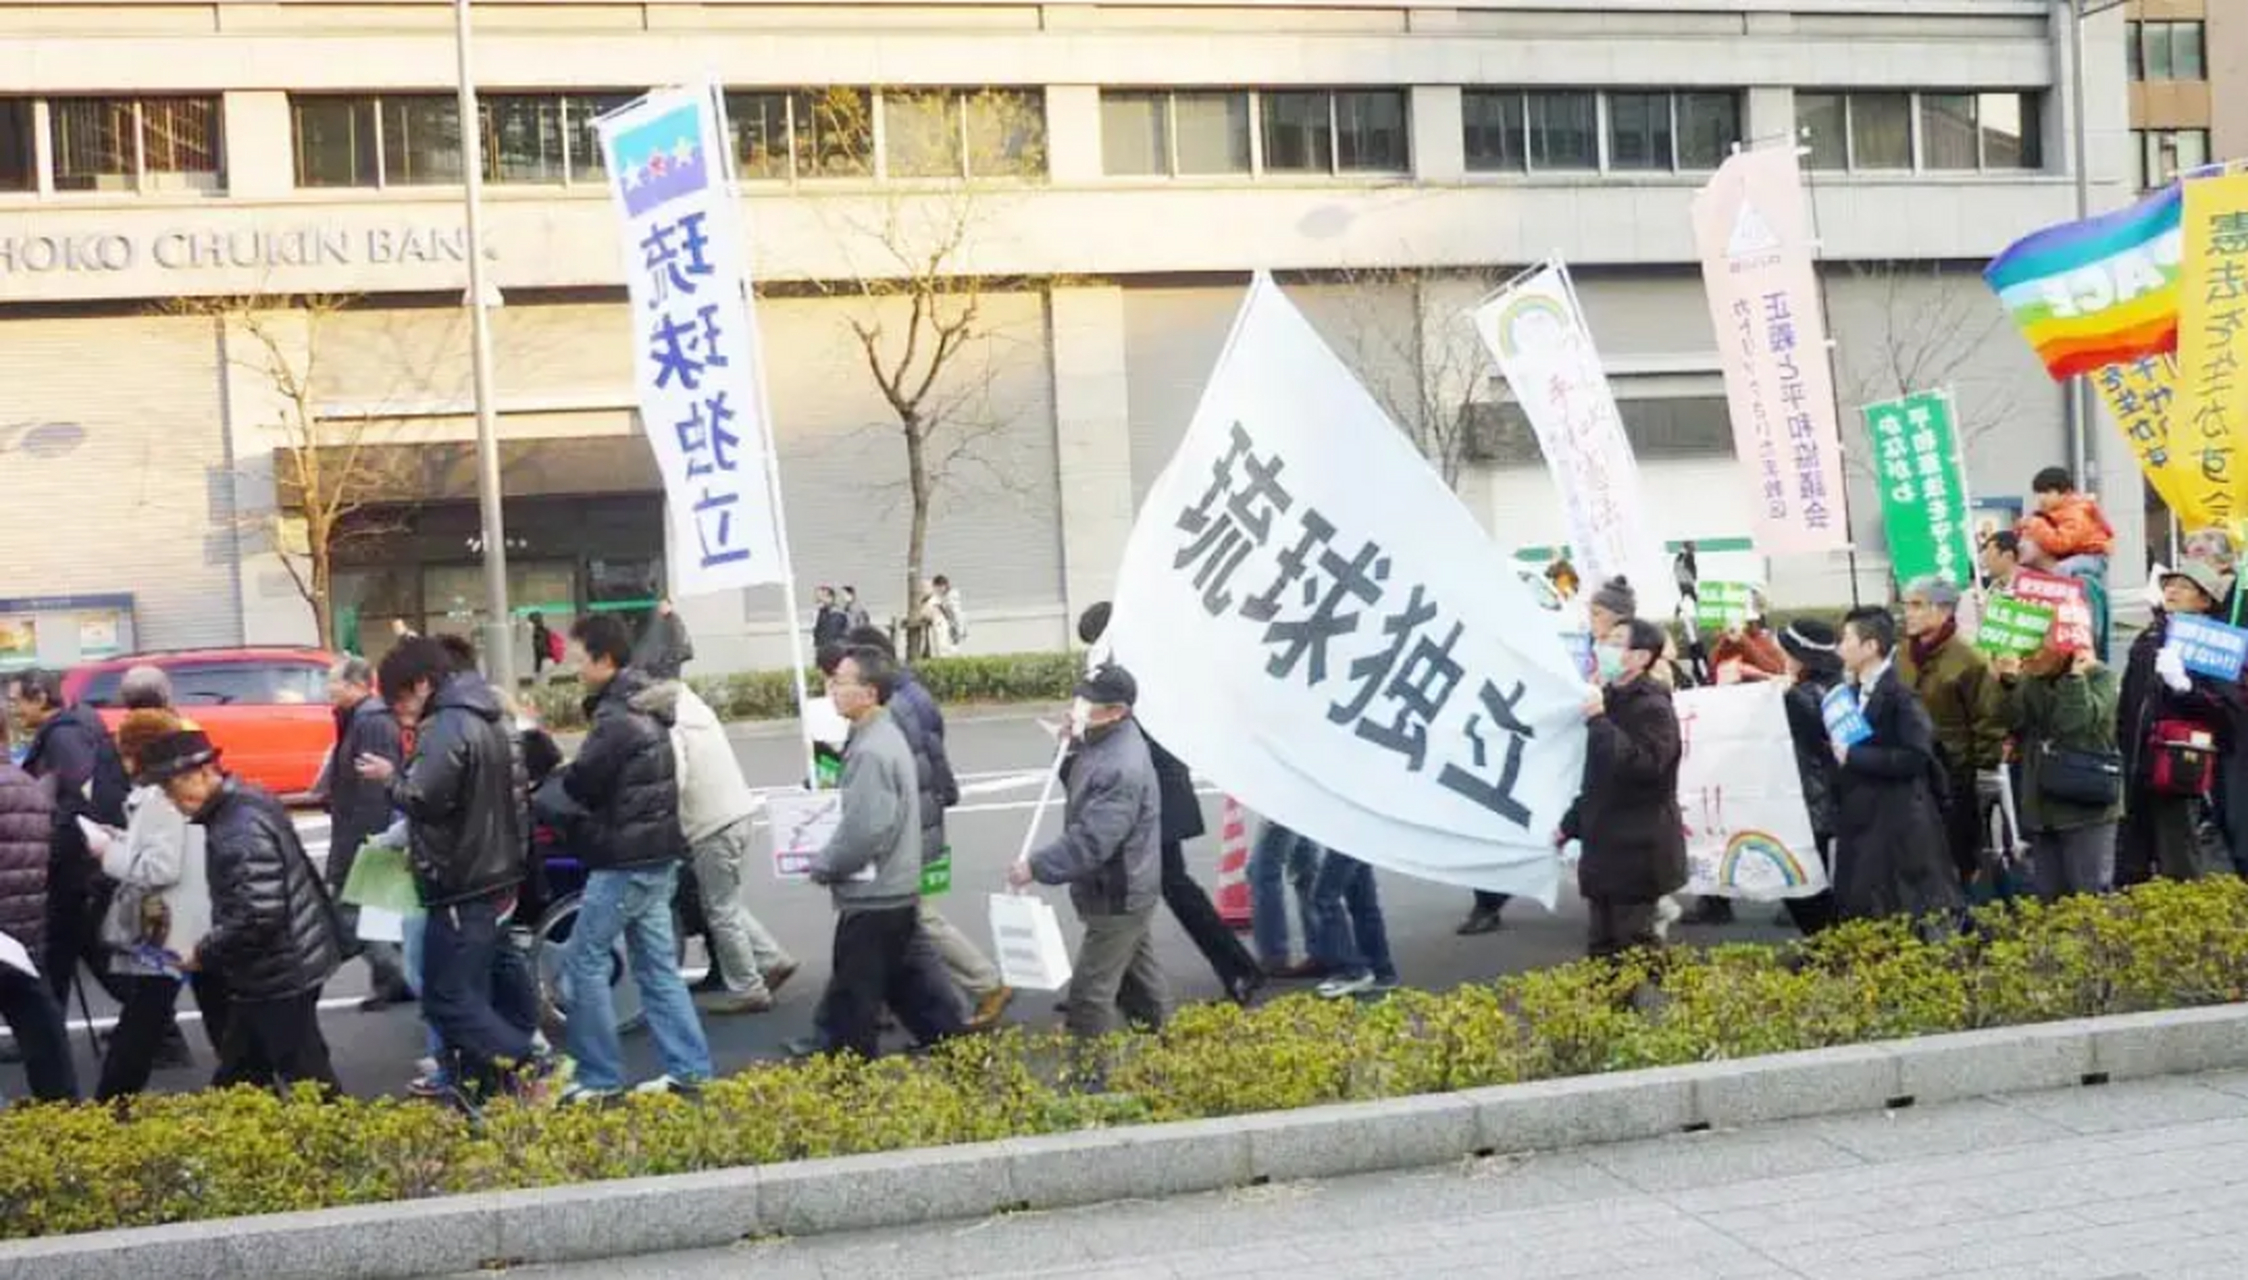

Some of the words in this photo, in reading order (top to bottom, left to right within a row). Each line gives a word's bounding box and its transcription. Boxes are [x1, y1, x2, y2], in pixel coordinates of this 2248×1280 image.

[152, 228, 351, 270] CHUKIN
[1173, 419, 1534, 834] 琉球独立
